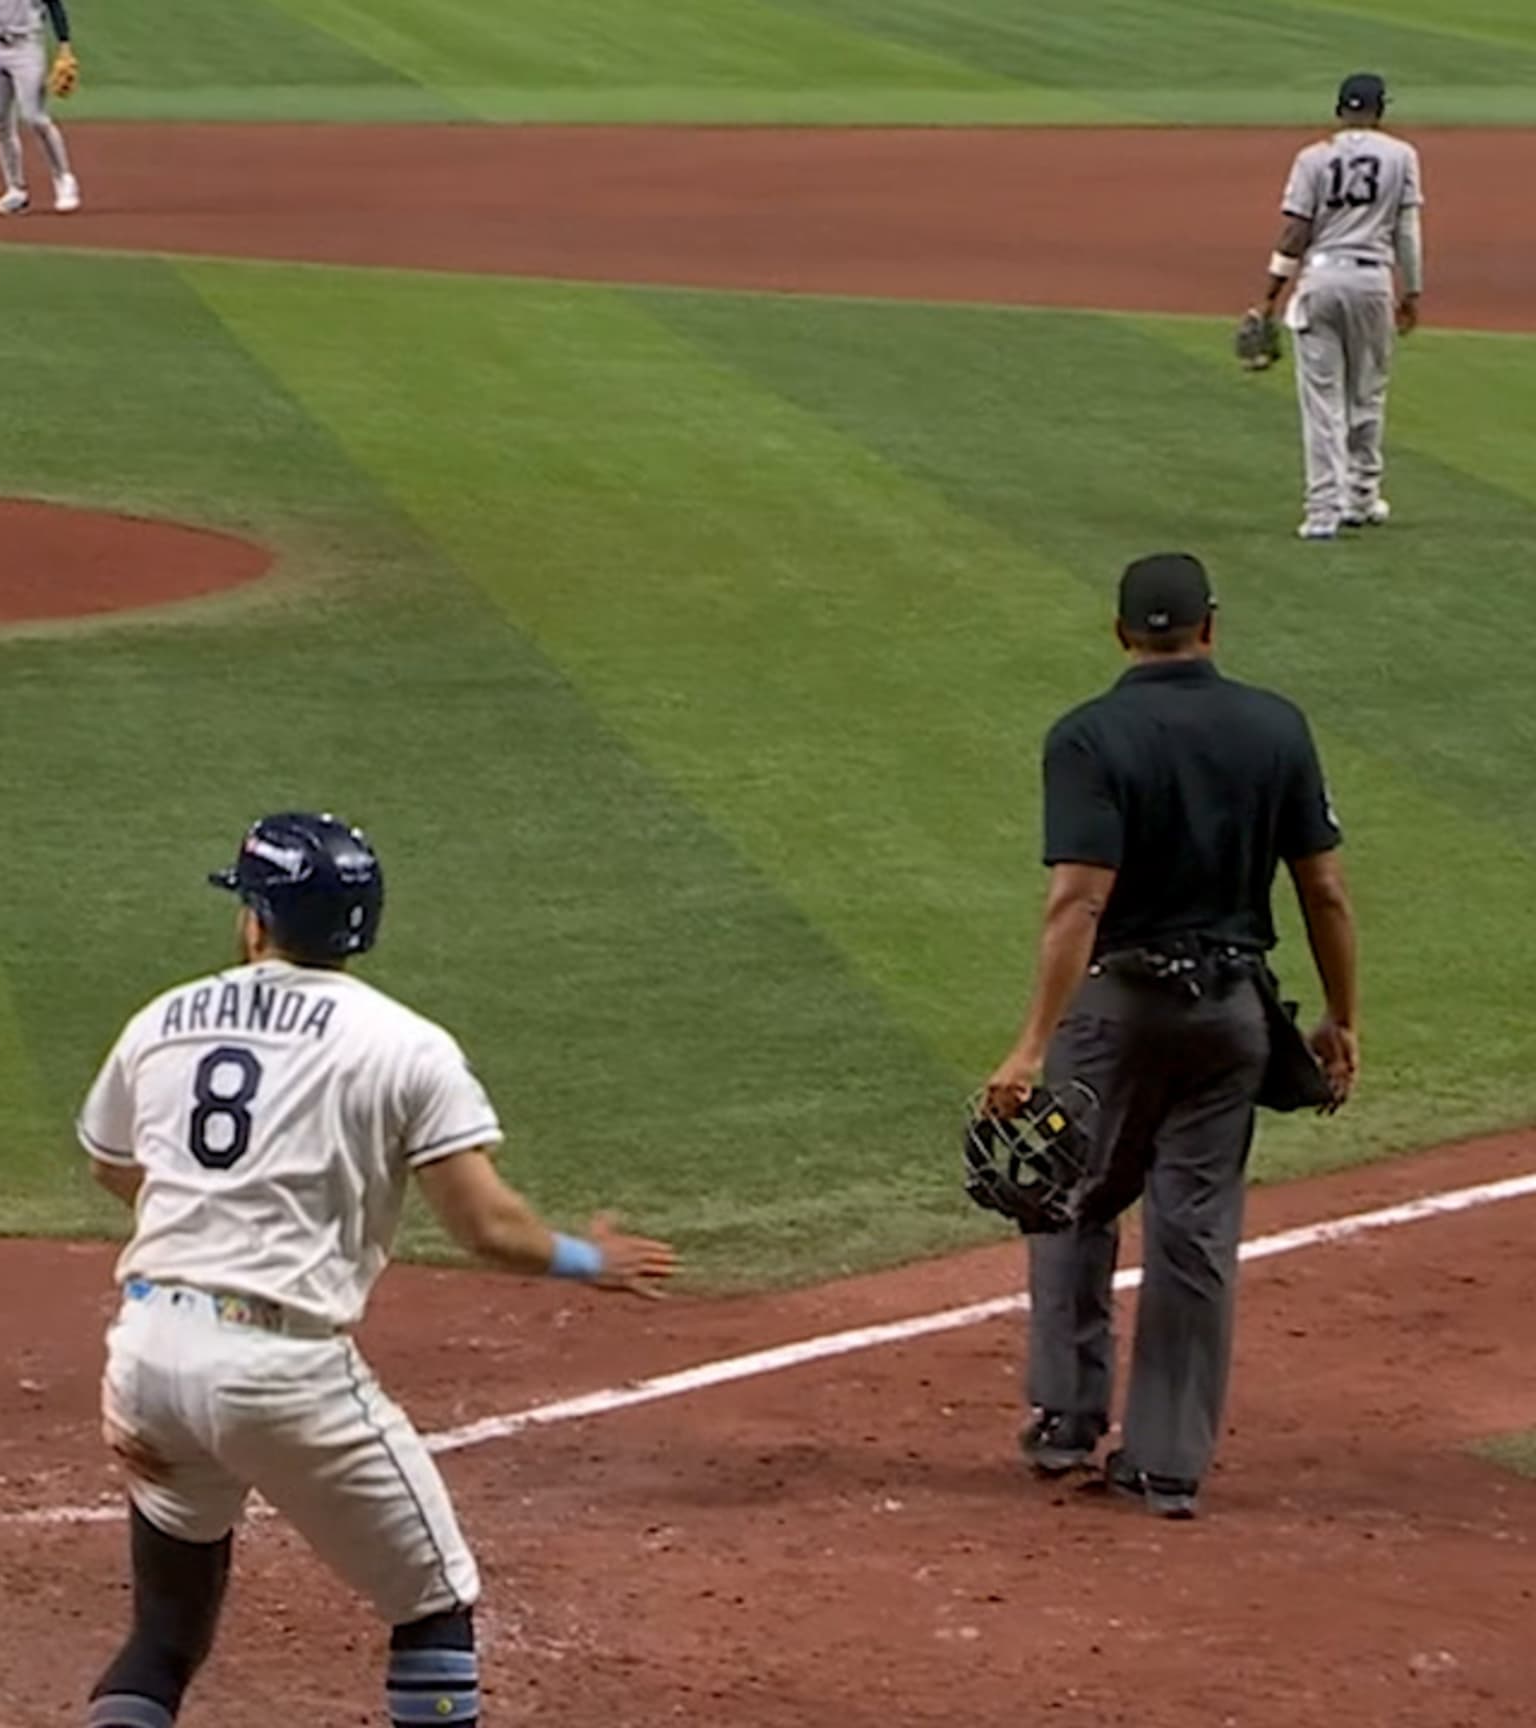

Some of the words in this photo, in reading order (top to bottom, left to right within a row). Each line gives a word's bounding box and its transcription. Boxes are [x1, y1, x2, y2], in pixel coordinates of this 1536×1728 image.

[1326, 156, 1379, 208] 13
[162, 983, 335, 1038] ARANDA
[190, 1046, 262, 1170] 8
